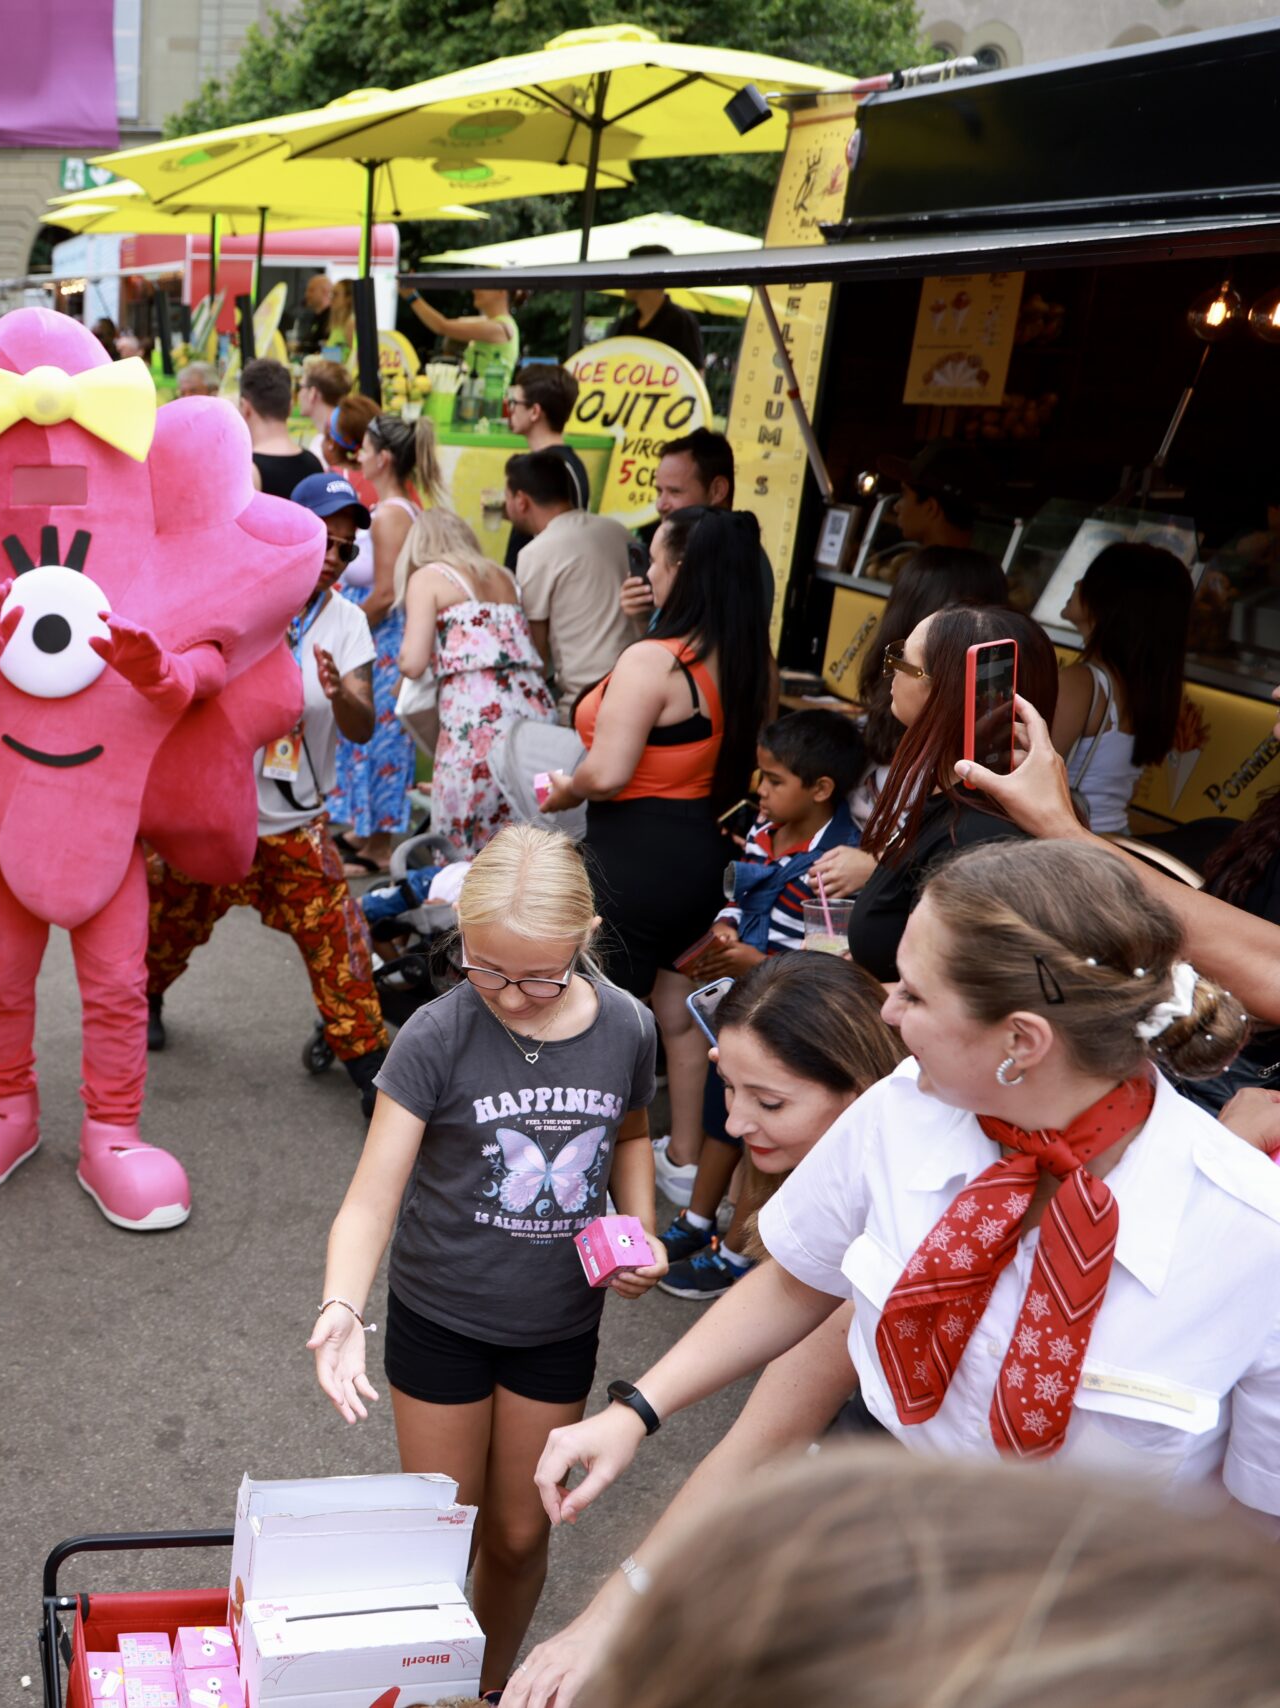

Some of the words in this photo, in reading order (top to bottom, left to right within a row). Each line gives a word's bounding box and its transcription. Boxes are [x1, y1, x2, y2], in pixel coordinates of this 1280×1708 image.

[378, 350, 401, 368] OLD
[573, 361, 608, 383] ICE
[613, 362, 680, 388] COLD
[575, 389, 697, 432] OJITO
[1203, 737, 1280, 814] POMME
[472, 1087, 623, 1124] HAPPINESS
[474, 1211, 490, 1224] IS
[492, 1215, 551, 1232] ALWAYS
[551, 1219, 572, 1231] MY
[574, 1215, 598, 1229] MO
[402, 1653, 451, 1668] Biberli
